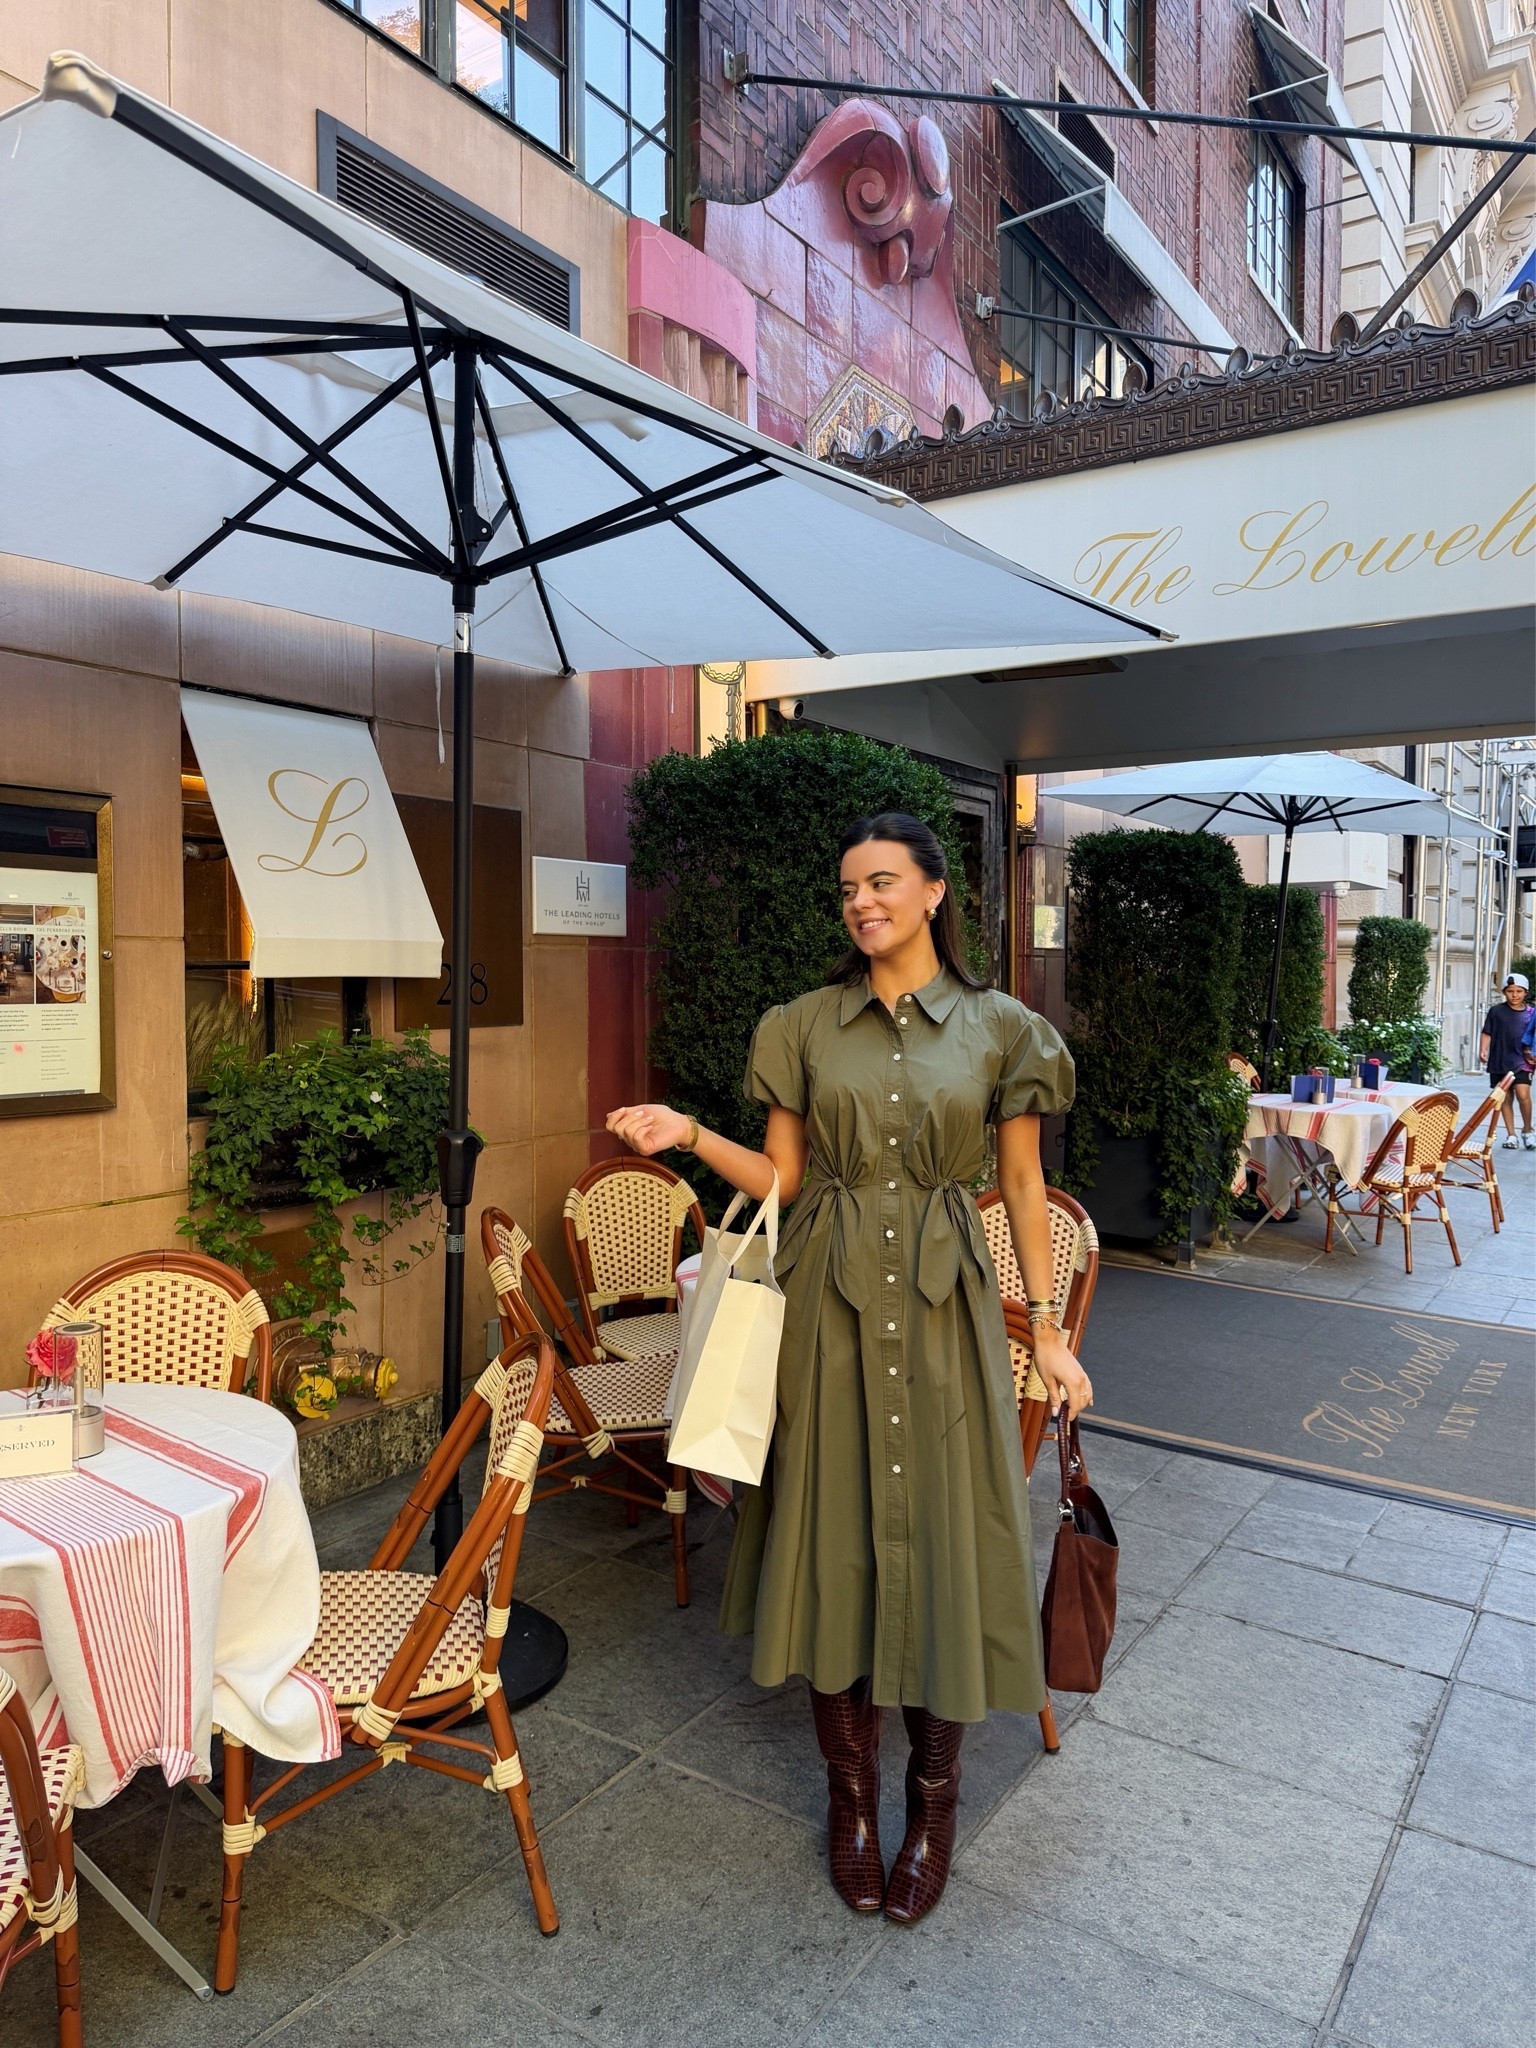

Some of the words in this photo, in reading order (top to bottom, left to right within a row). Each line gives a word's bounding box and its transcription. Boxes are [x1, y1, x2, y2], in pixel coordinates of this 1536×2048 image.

[1073, 525, 1195, 608] The
[257, 768, 370, 877] L
[544, 909, 559, 917] THE
[561, 910, 592, 919] LEADING
[594, 912, 621, 920] HOTELS
[436, 962, 489, 1006] 28
[1340, 1320, 1460, 1410] Lowell
[1436, 1402, 1481, 1439] NEW
[1461, 1359, 1508, 1395] YORK
[1302, 1400, 1406, 1458] The
